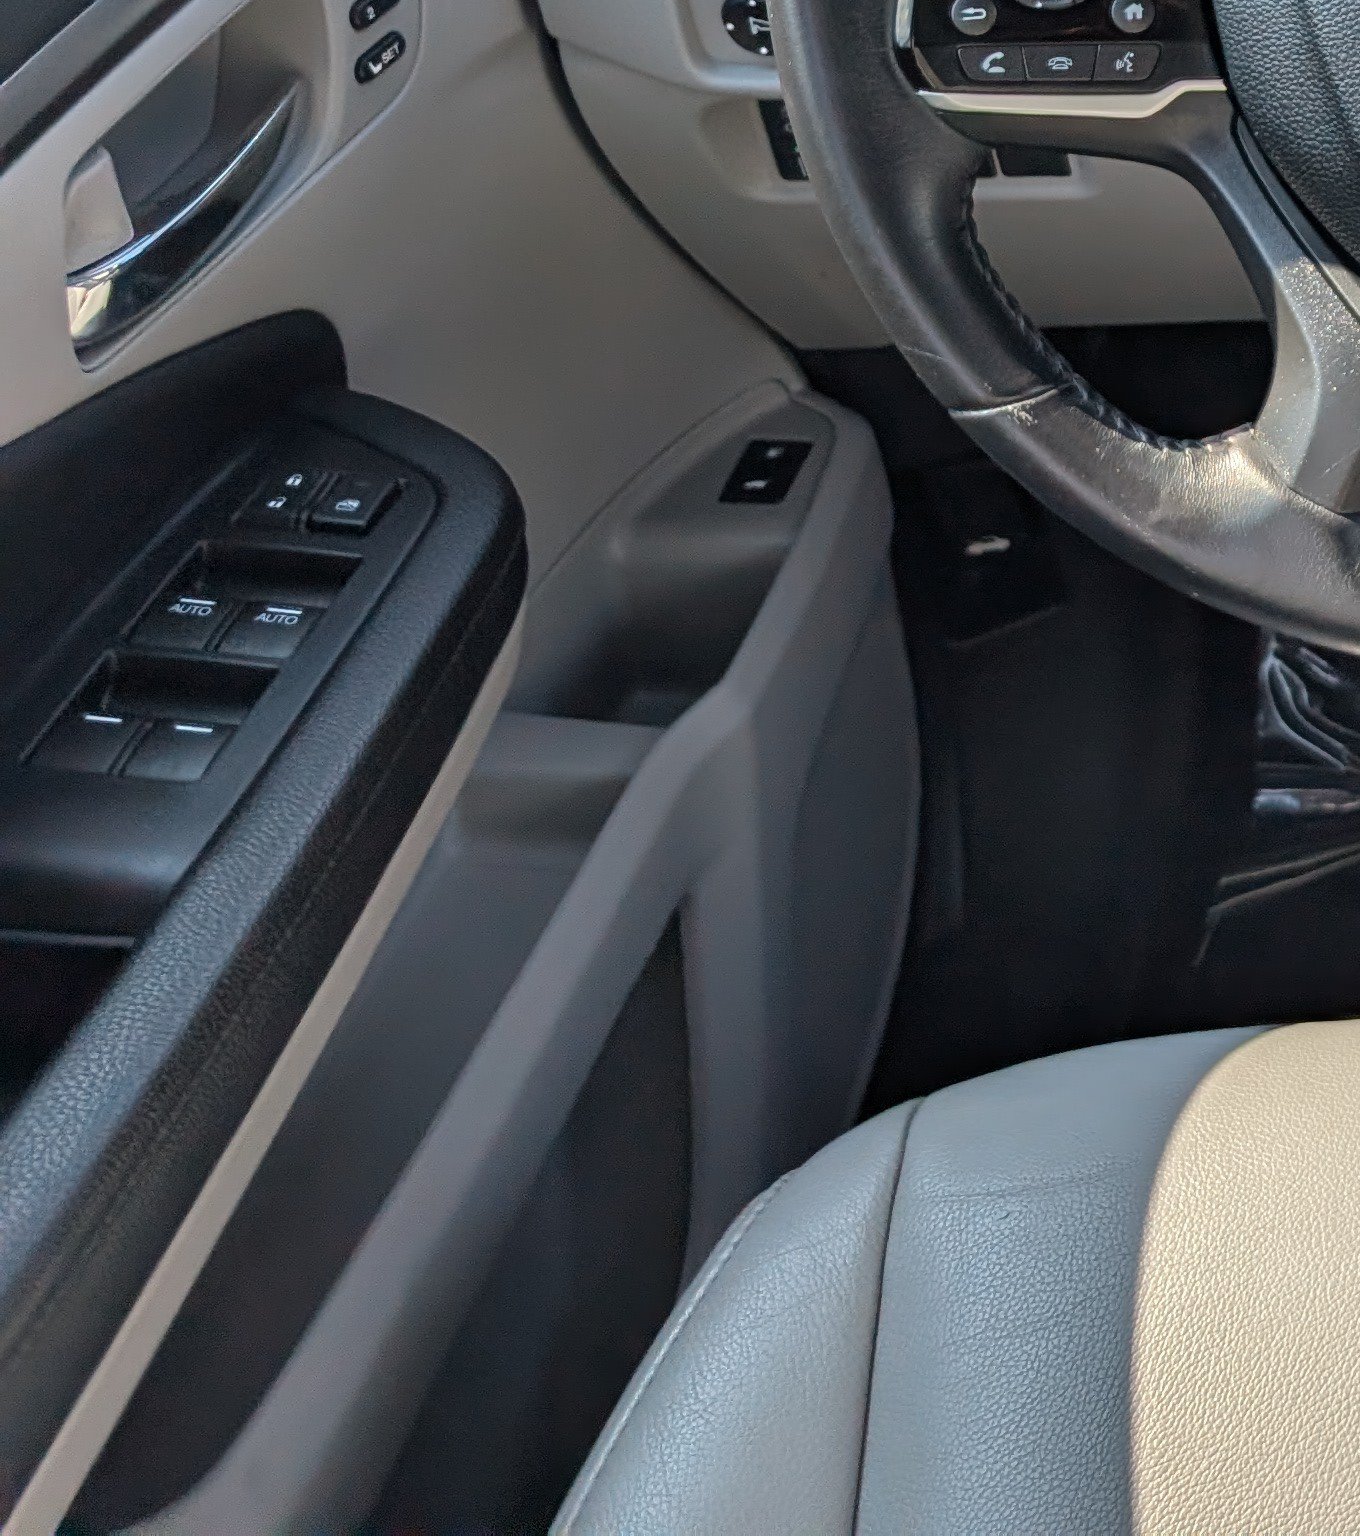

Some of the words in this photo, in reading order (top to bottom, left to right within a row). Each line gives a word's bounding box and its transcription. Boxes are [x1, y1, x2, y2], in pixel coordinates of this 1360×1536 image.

[381, 41, 401, 64] SET
[168, 602, 212, 617] AUTO
[254, 612, 299, 626] AUTO
